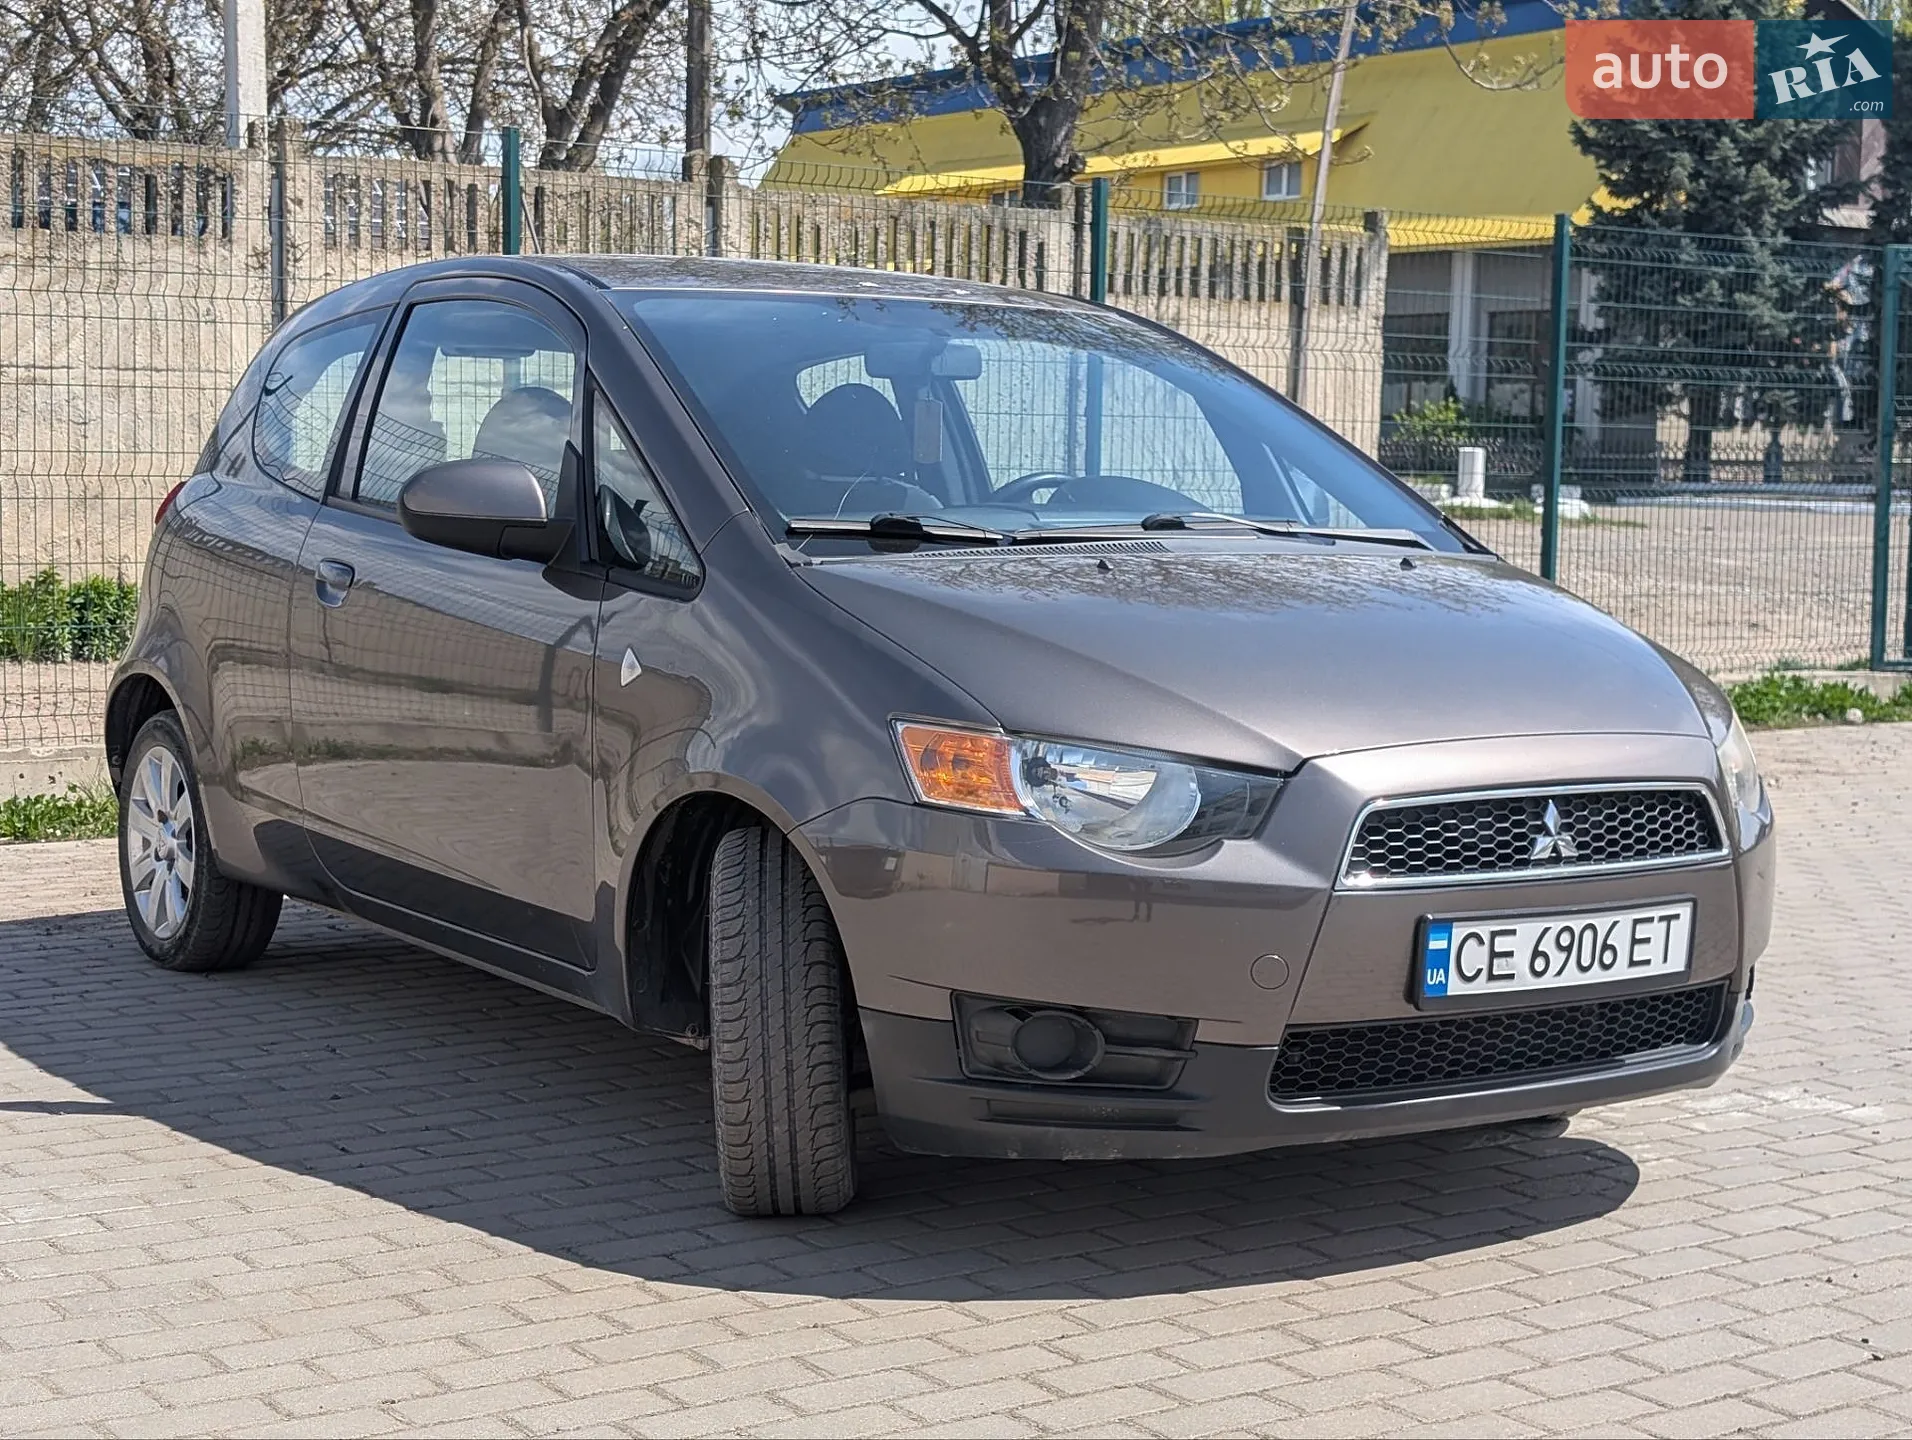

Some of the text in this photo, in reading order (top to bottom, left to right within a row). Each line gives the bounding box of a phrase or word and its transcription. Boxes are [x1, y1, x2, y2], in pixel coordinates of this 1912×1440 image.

[1455, 913, 1681, 983] CE 6906 ET
[1427, 968, 1446, 985] UA
